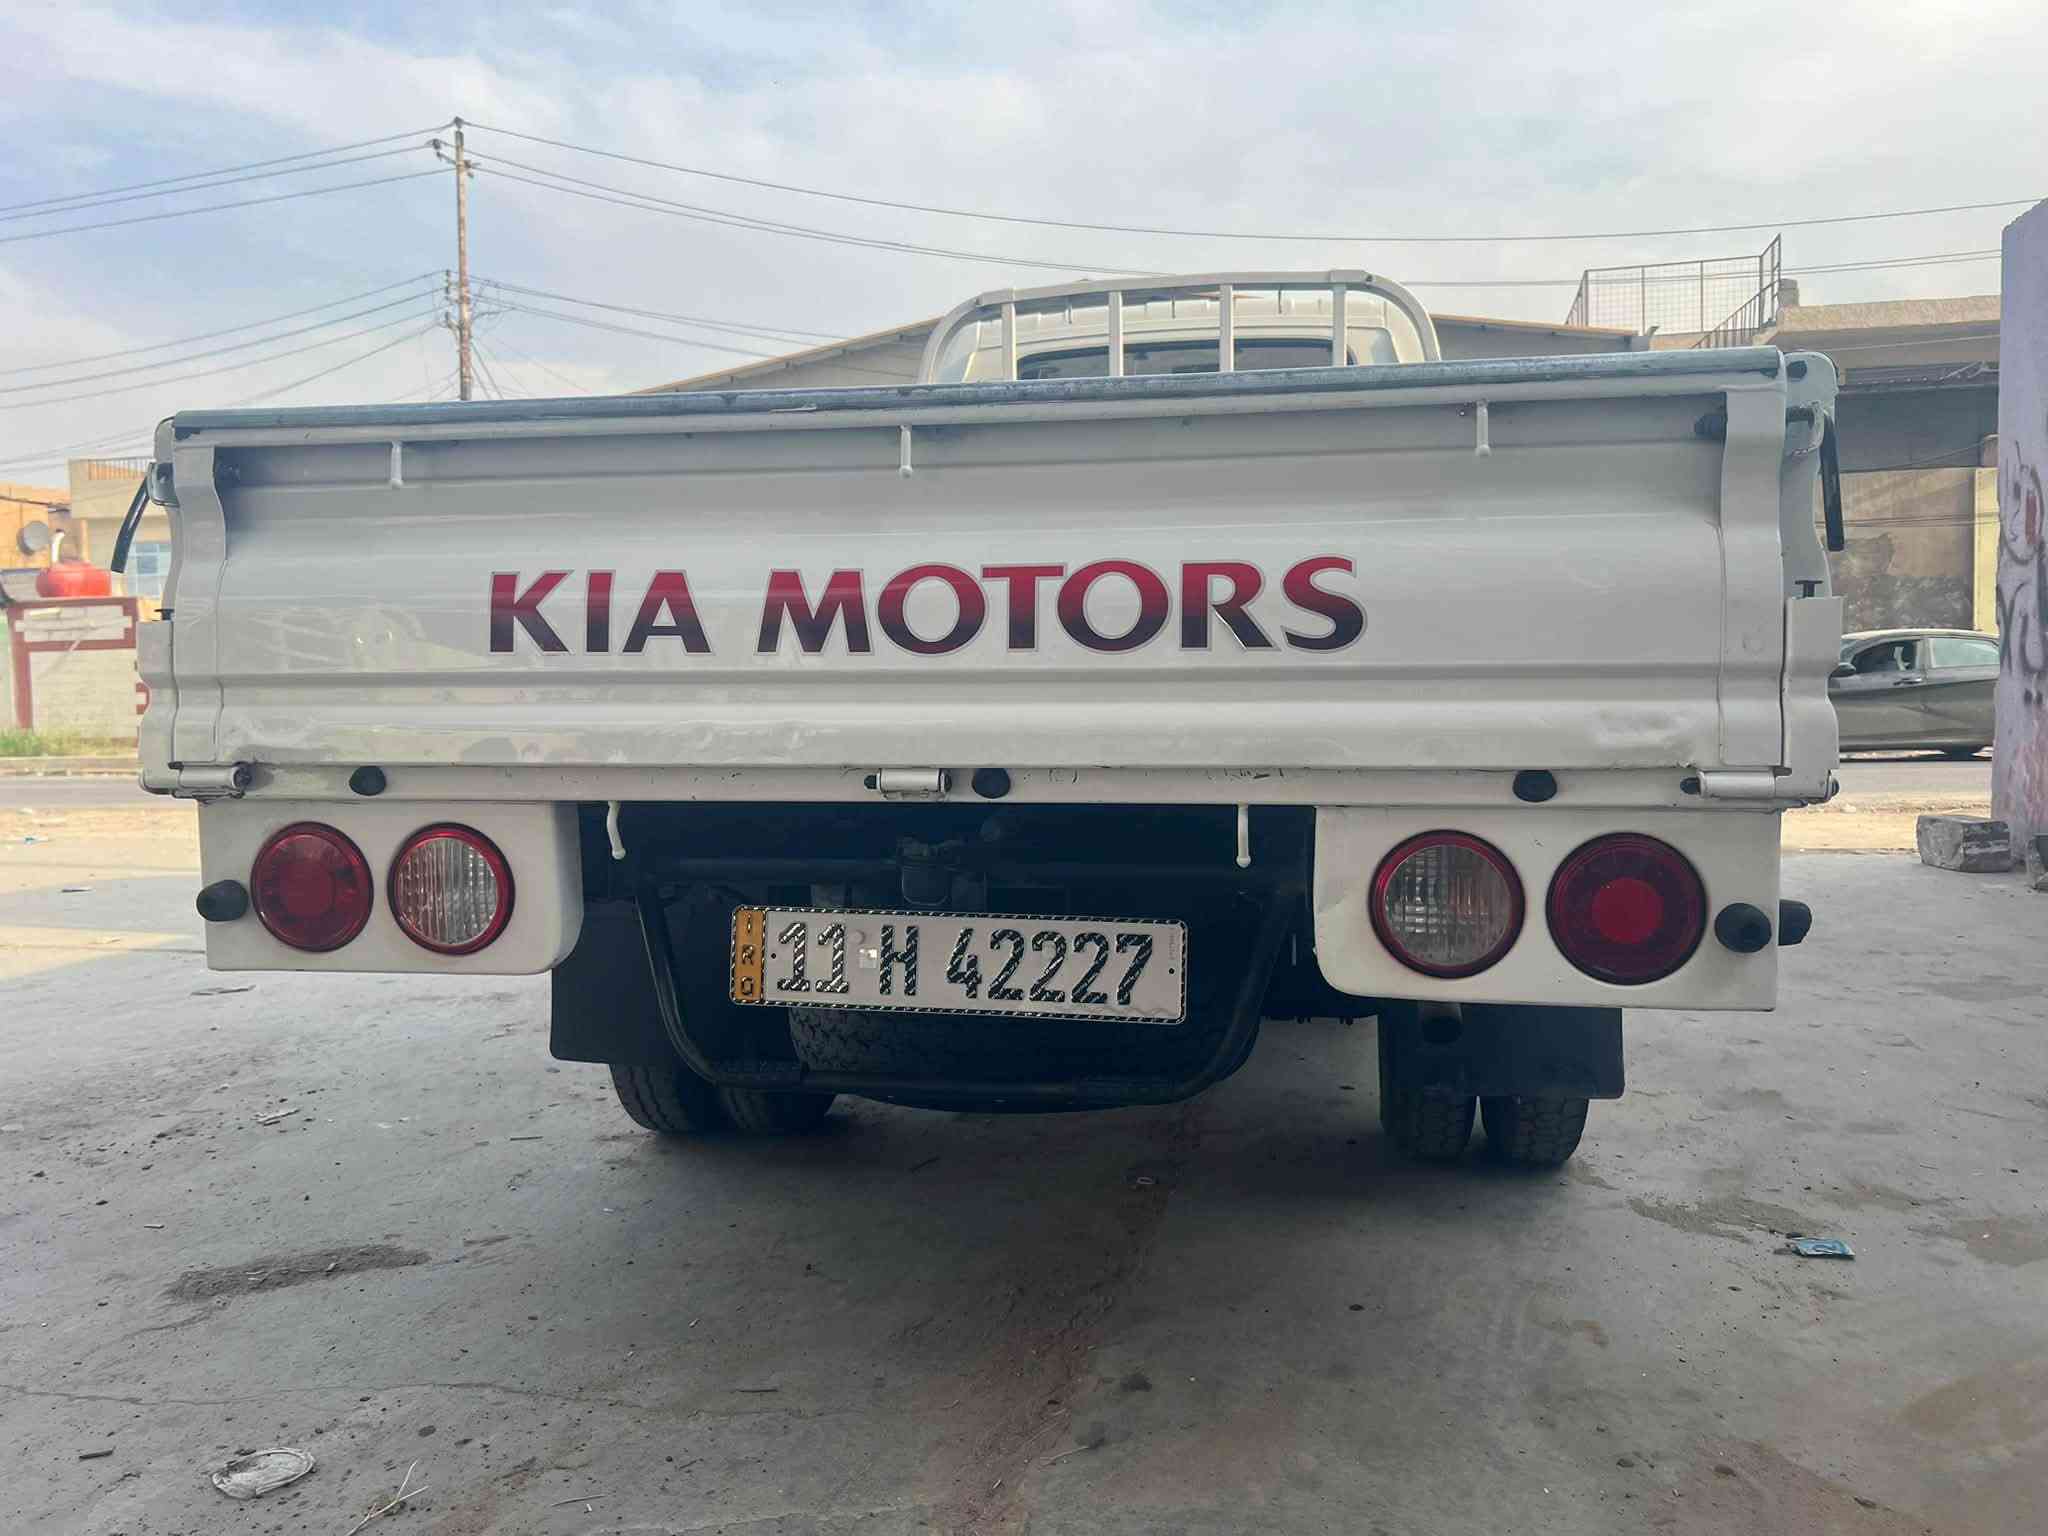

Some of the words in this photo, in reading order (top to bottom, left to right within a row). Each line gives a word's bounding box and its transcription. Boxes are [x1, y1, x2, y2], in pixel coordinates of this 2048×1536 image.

[489, 569, 713, 656] KIA
[754, 556, 1367, 657] MOTORS
[776, 922, 849, 993] 11
[879, 924, 919, 996] H
[946, 928, 1154, 1005] 42227
